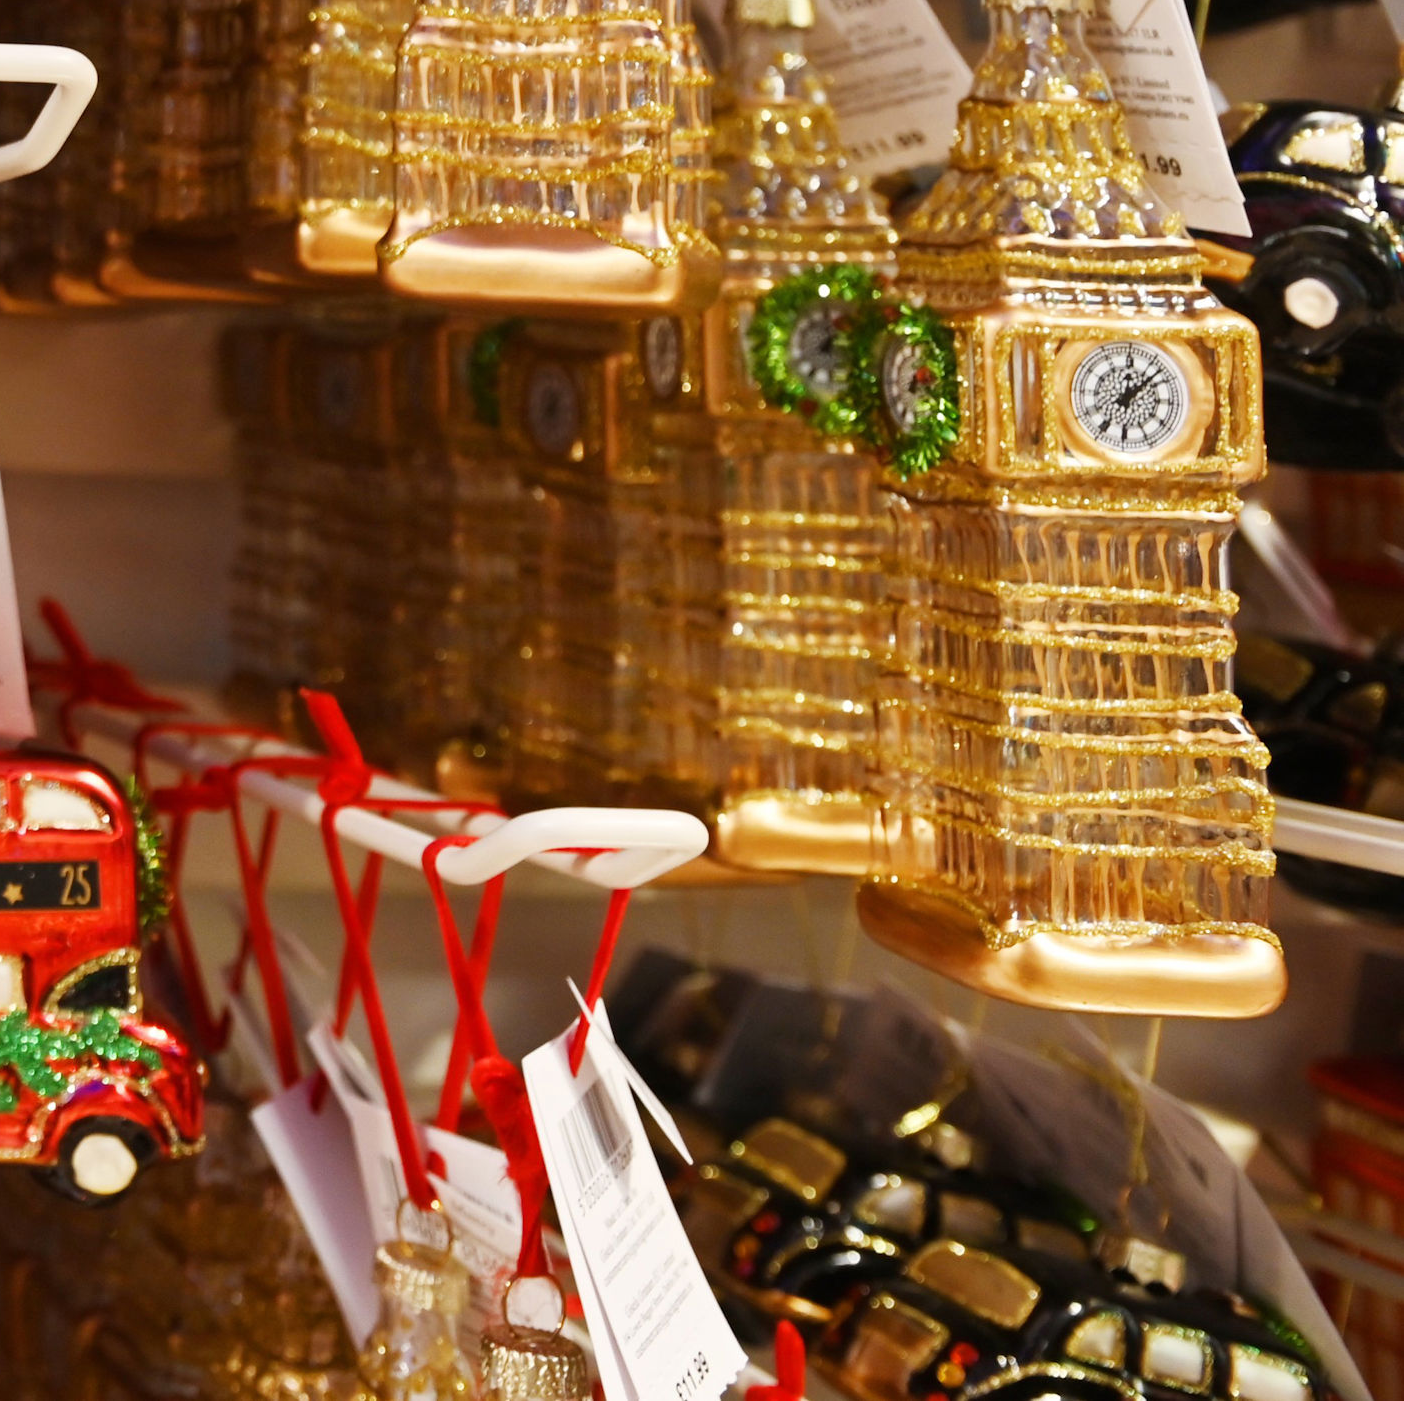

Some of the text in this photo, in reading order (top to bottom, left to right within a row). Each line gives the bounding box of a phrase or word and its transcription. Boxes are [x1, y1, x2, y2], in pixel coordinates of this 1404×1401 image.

[1141, 153, 1183, 178] 1.99
[59, 863, 92, 906] 25
[675, 1350, 711, 1401] £11.99
